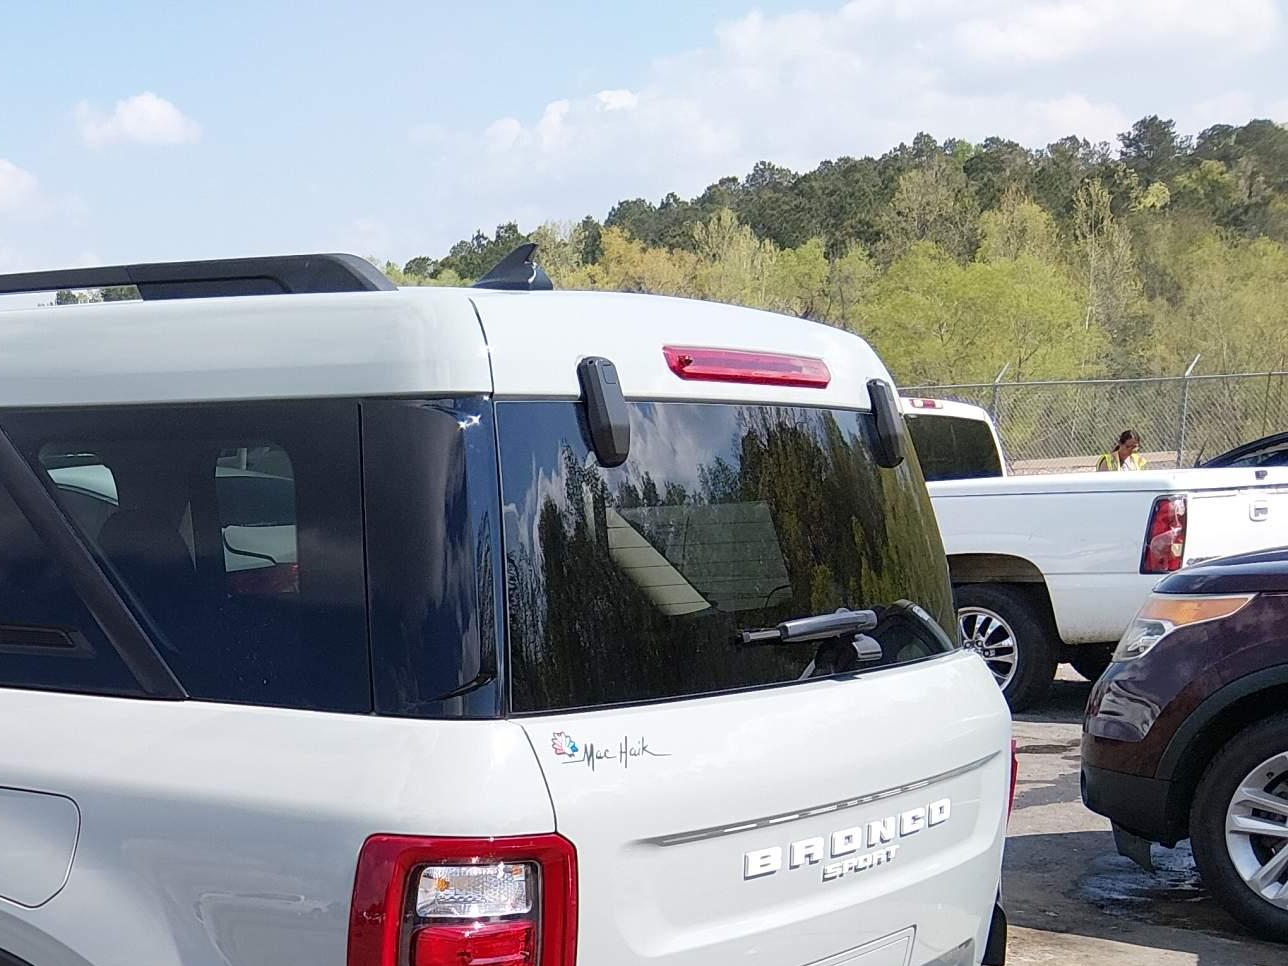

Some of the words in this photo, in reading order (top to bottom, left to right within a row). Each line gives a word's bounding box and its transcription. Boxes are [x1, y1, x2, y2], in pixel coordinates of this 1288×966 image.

[562, 743, 616, 772] Mac
[619, 735, 672, 769] Haik
[743, 798, 951, 881] BRONCO
[822, 845, 900, 882] SPORT
